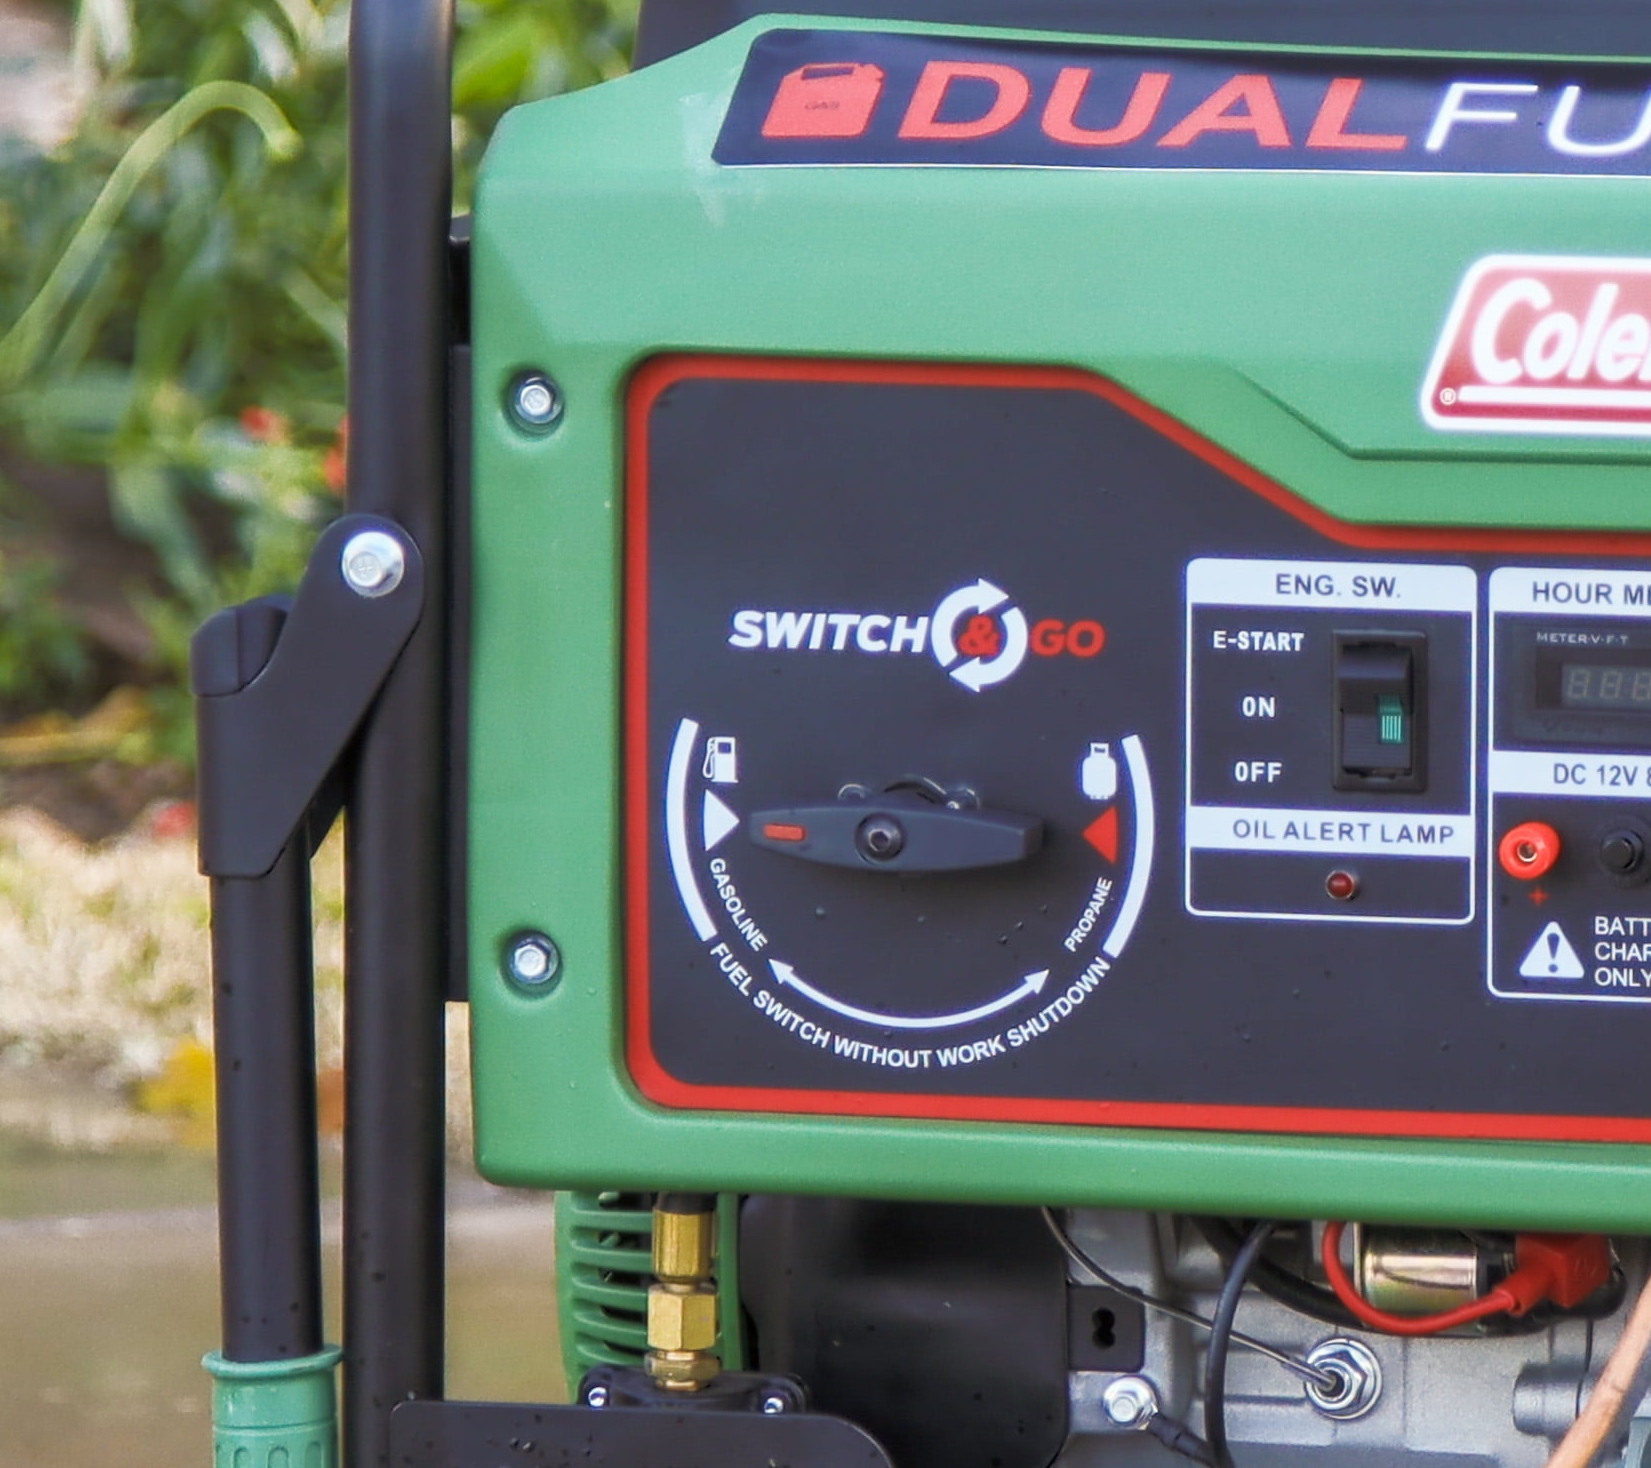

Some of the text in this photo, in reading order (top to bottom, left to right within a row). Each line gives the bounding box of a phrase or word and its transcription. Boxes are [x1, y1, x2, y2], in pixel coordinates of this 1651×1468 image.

[1275, 573, 1401, 599] ENG. SW.
[1532, 581, 1613, 607] HOUR
[728, 610, 928, 653] SWITCH
[1031, 620, 1105, 658] GO
[1213, 630, 1304, 653] E-START
[1243, 696, 1275, 718] ON
[1234, 761, 1282, 784] OFF
[1553, 763, 1587, 787] DC
[1596, 765, 1639, 788] 12V
[1232, 819, 1455, 845] OIL ALERT LAMP
[710, 859, 768, 952] GASOLINE
[1065, 878, 1113, 953] PROPANE
[710, 943, 1111, 1069] FUEL SWITCH WITHOUT WORK SHUTDOWN
